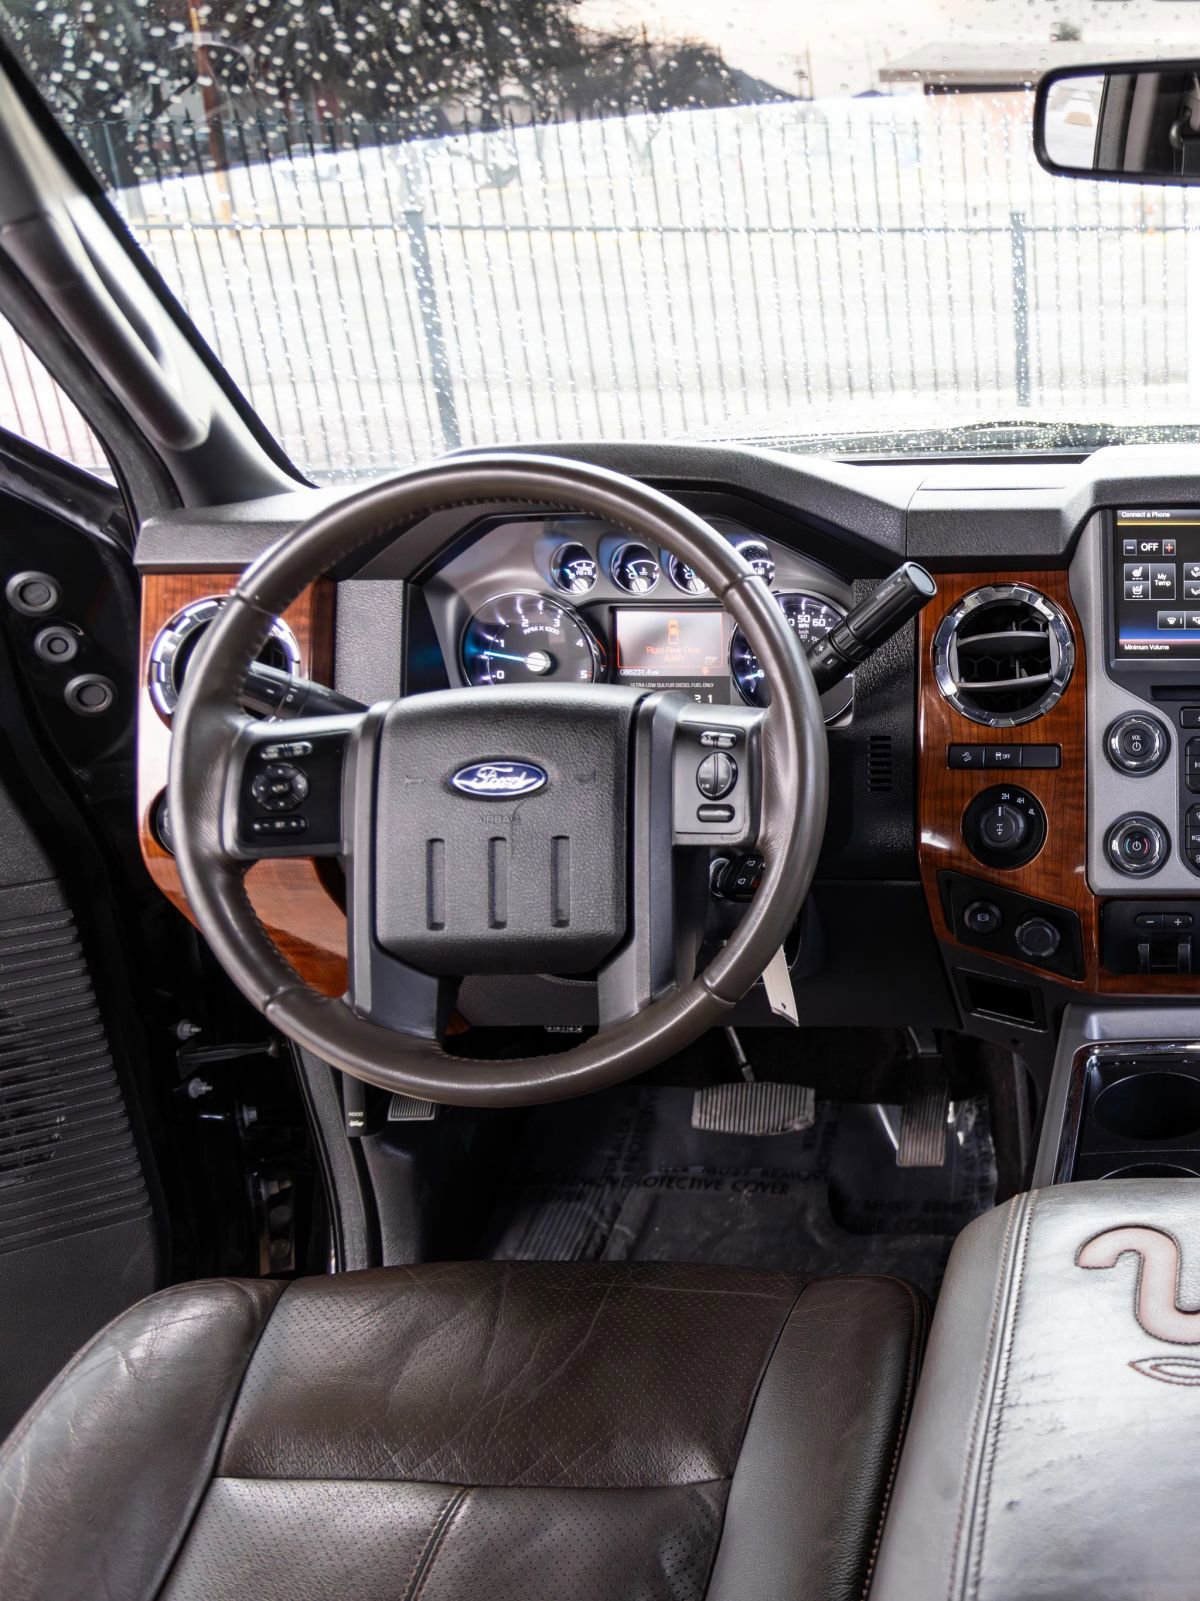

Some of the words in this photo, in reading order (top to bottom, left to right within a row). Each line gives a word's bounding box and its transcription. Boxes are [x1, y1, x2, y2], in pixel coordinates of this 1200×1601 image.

[1140, 542, 1158, 552] OFF
[521, 618, 529, 628] 2
[554, 618, 560, 627] 3
[797, 615, 810, 623] 50
[812, 618, 826, 627] 60
[523, 626, 538, 636] RPM
[500, 640, 505, 648] 1
[576, 639, 584, 648] 4
[496, 670, 505, 679] 0
[580, 670, 588, 679] 5
[455, 766, 537, 790] Ford
